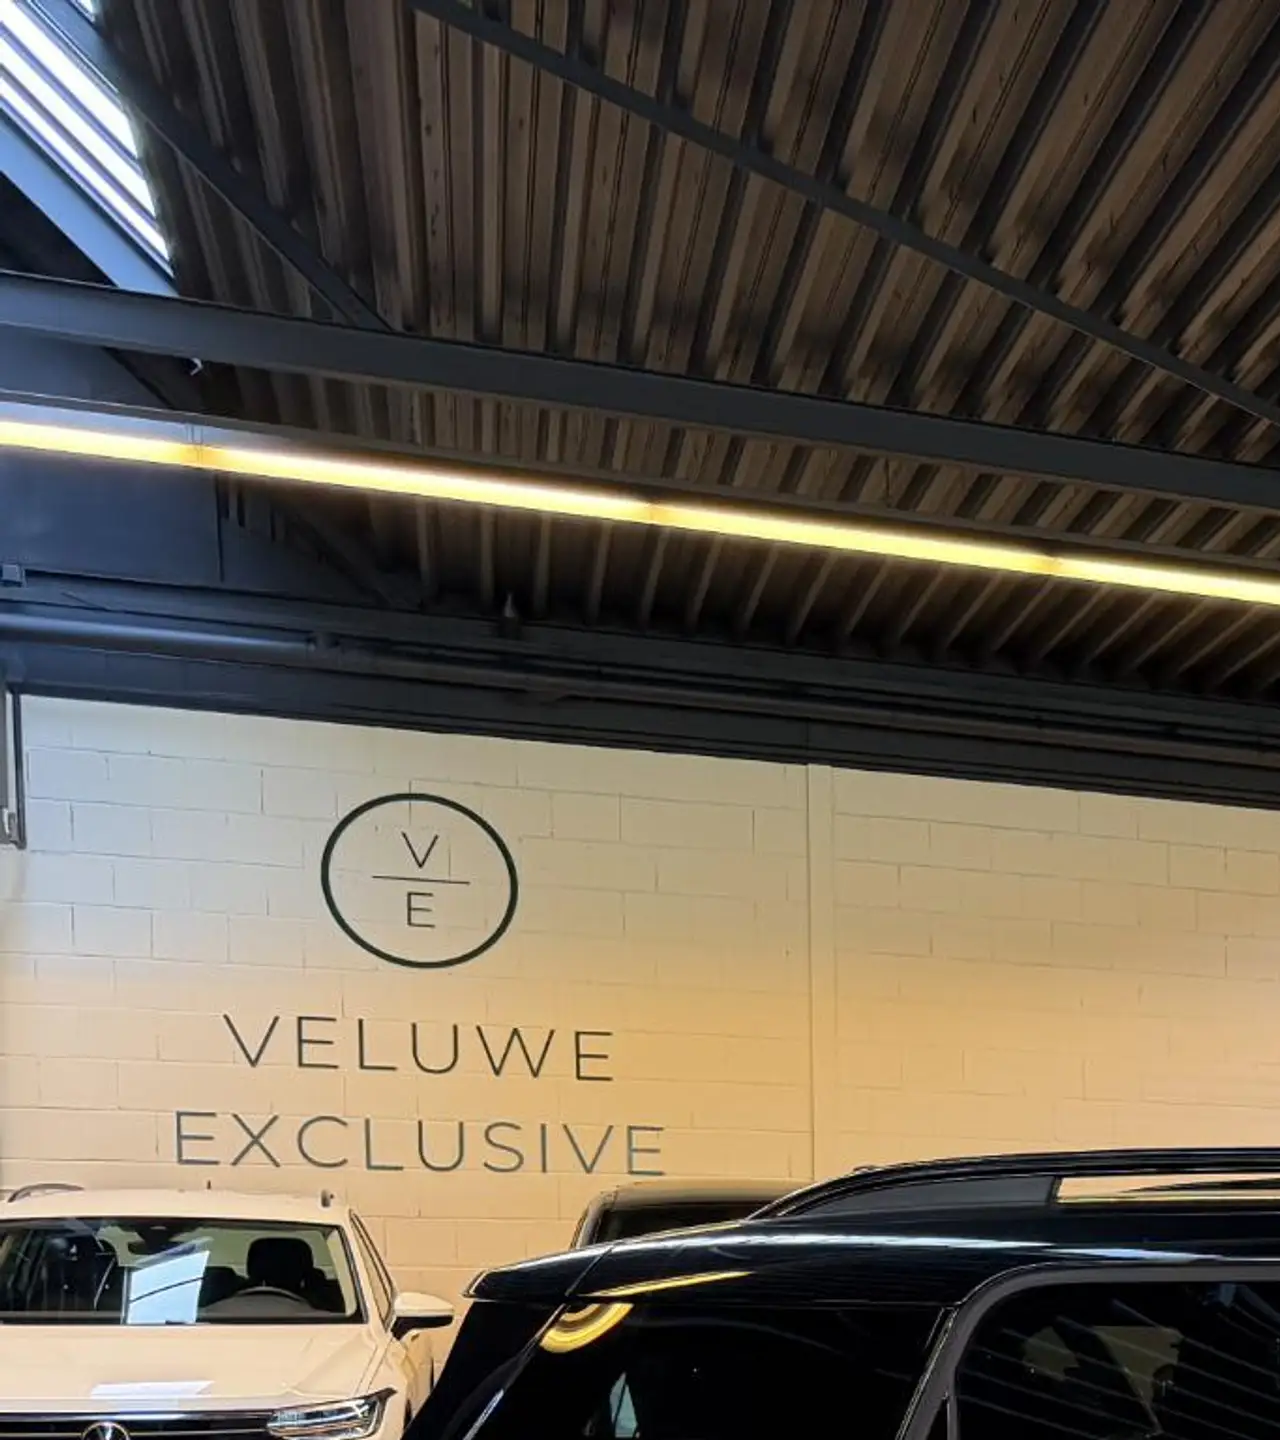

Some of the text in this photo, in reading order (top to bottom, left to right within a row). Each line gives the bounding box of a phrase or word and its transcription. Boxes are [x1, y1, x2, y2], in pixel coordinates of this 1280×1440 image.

[401, 831, 438, 868] V
[406, 891, 436, 928] E
[222, 1013, 614, 1081] VELUWE
[175, 1111, 665, 1175] EXCLUSIVE
